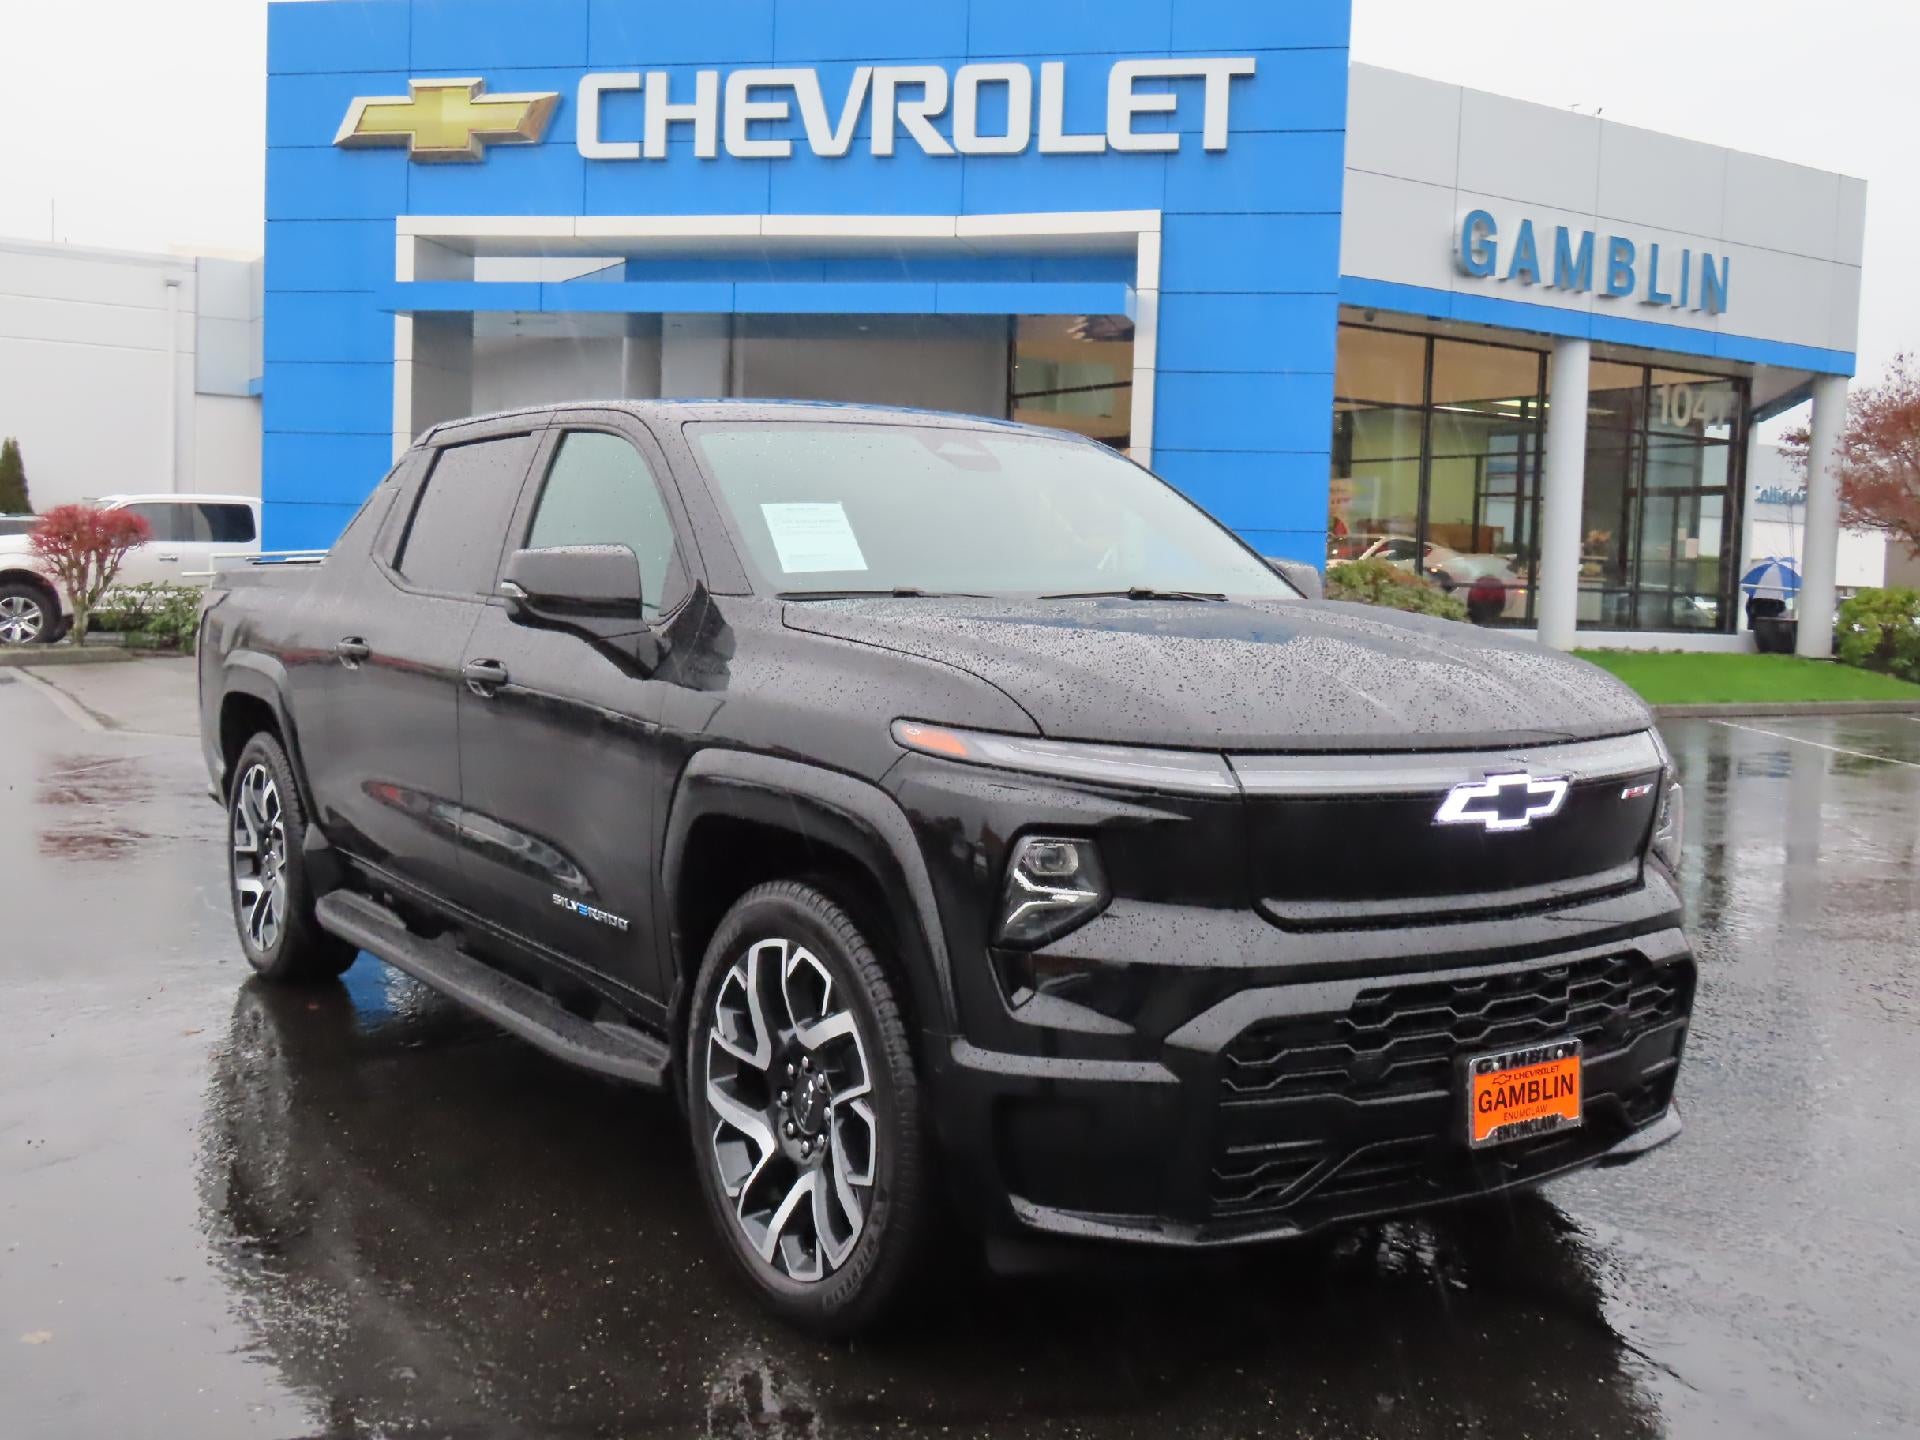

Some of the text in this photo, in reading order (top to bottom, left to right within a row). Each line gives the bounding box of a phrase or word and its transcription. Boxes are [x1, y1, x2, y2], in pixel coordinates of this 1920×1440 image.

[576, 58, 1256, 160] CHEVROLET
[1460, 209, 1730, 314] GAMBLIN
[552, 893, 629, 931] SILVERADO
[1478, 1073, 1574, 1113] GAMBLIN
[1513, 1065, 1560, 1081] CHEVROLET
